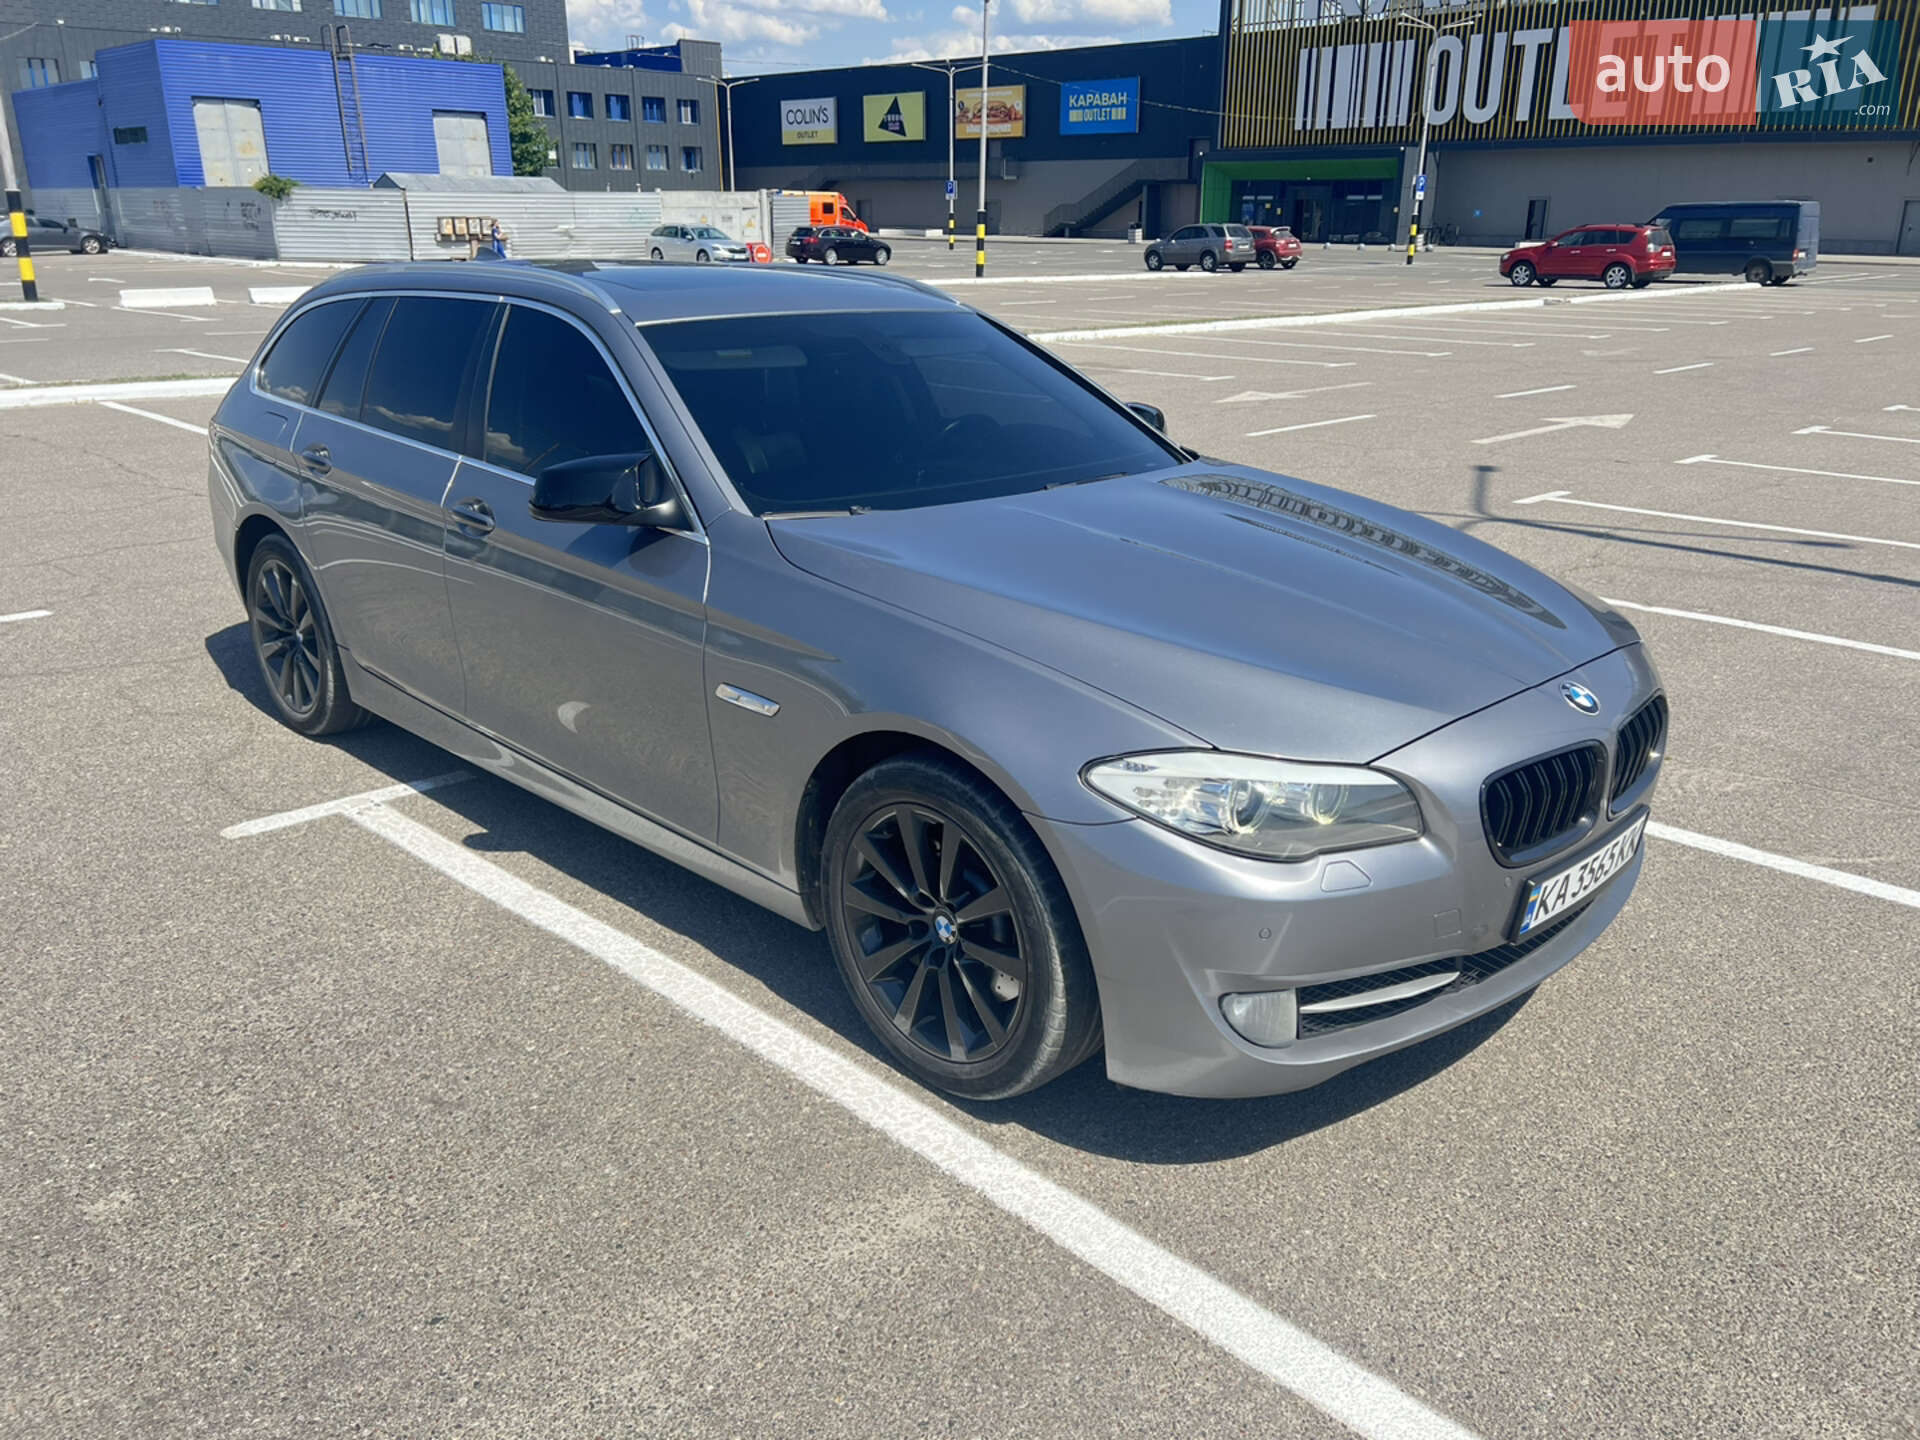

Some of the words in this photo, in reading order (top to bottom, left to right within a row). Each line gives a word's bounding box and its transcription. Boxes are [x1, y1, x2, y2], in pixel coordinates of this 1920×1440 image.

[1422, 17, 1691, 127] OUTLET
[786, 104, 830, 126] COLIN'S
[1083, 107, 1112, 122] OUTLET
[796, 130, 819, 139] OUTLET
